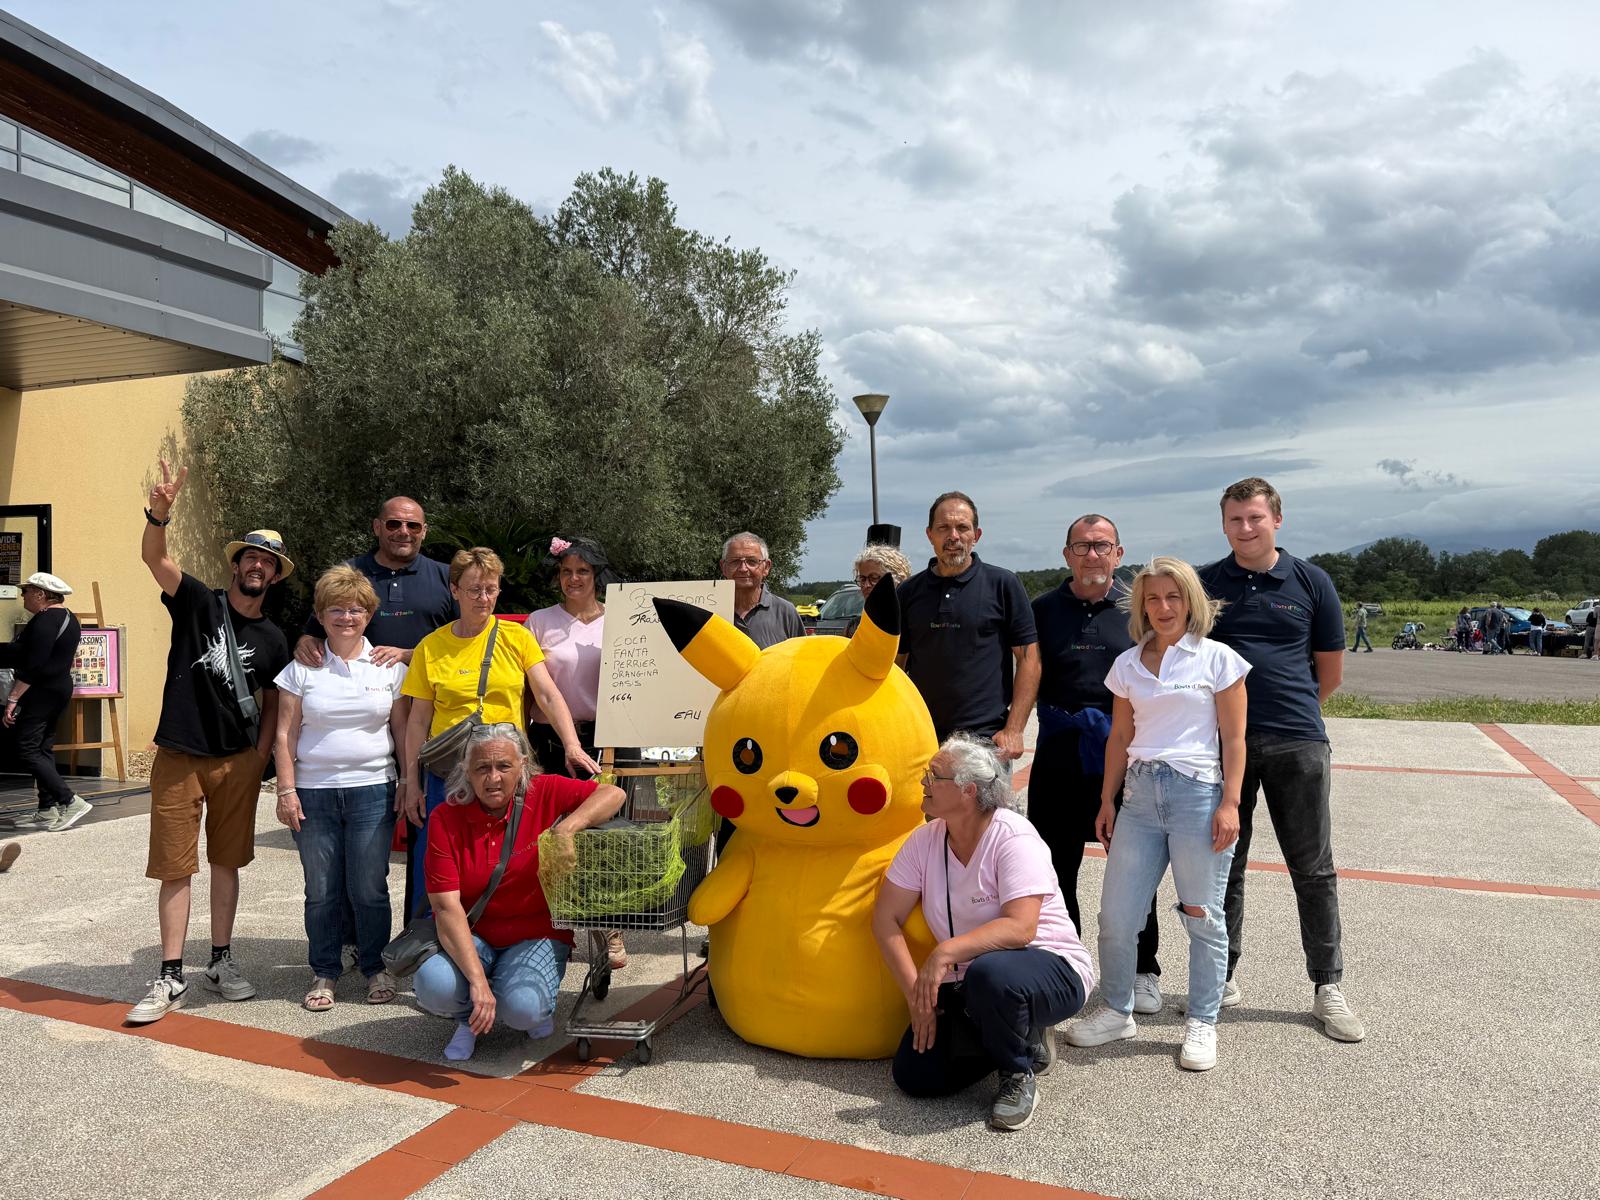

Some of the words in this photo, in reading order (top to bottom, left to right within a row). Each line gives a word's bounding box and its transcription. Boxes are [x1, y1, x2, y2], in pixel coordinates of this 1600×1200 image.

[613, 634, 647, 648] COCA
[613, 647, 648, 659] FANTA
[613, 658, 656, 670] PERRIER
[611, 668, 659, 680] ORANGINA
[611, 680, 642, 688] OASIS
[609, 693, 633, 704] 1664
[673, 709, 702, 720] EAU
